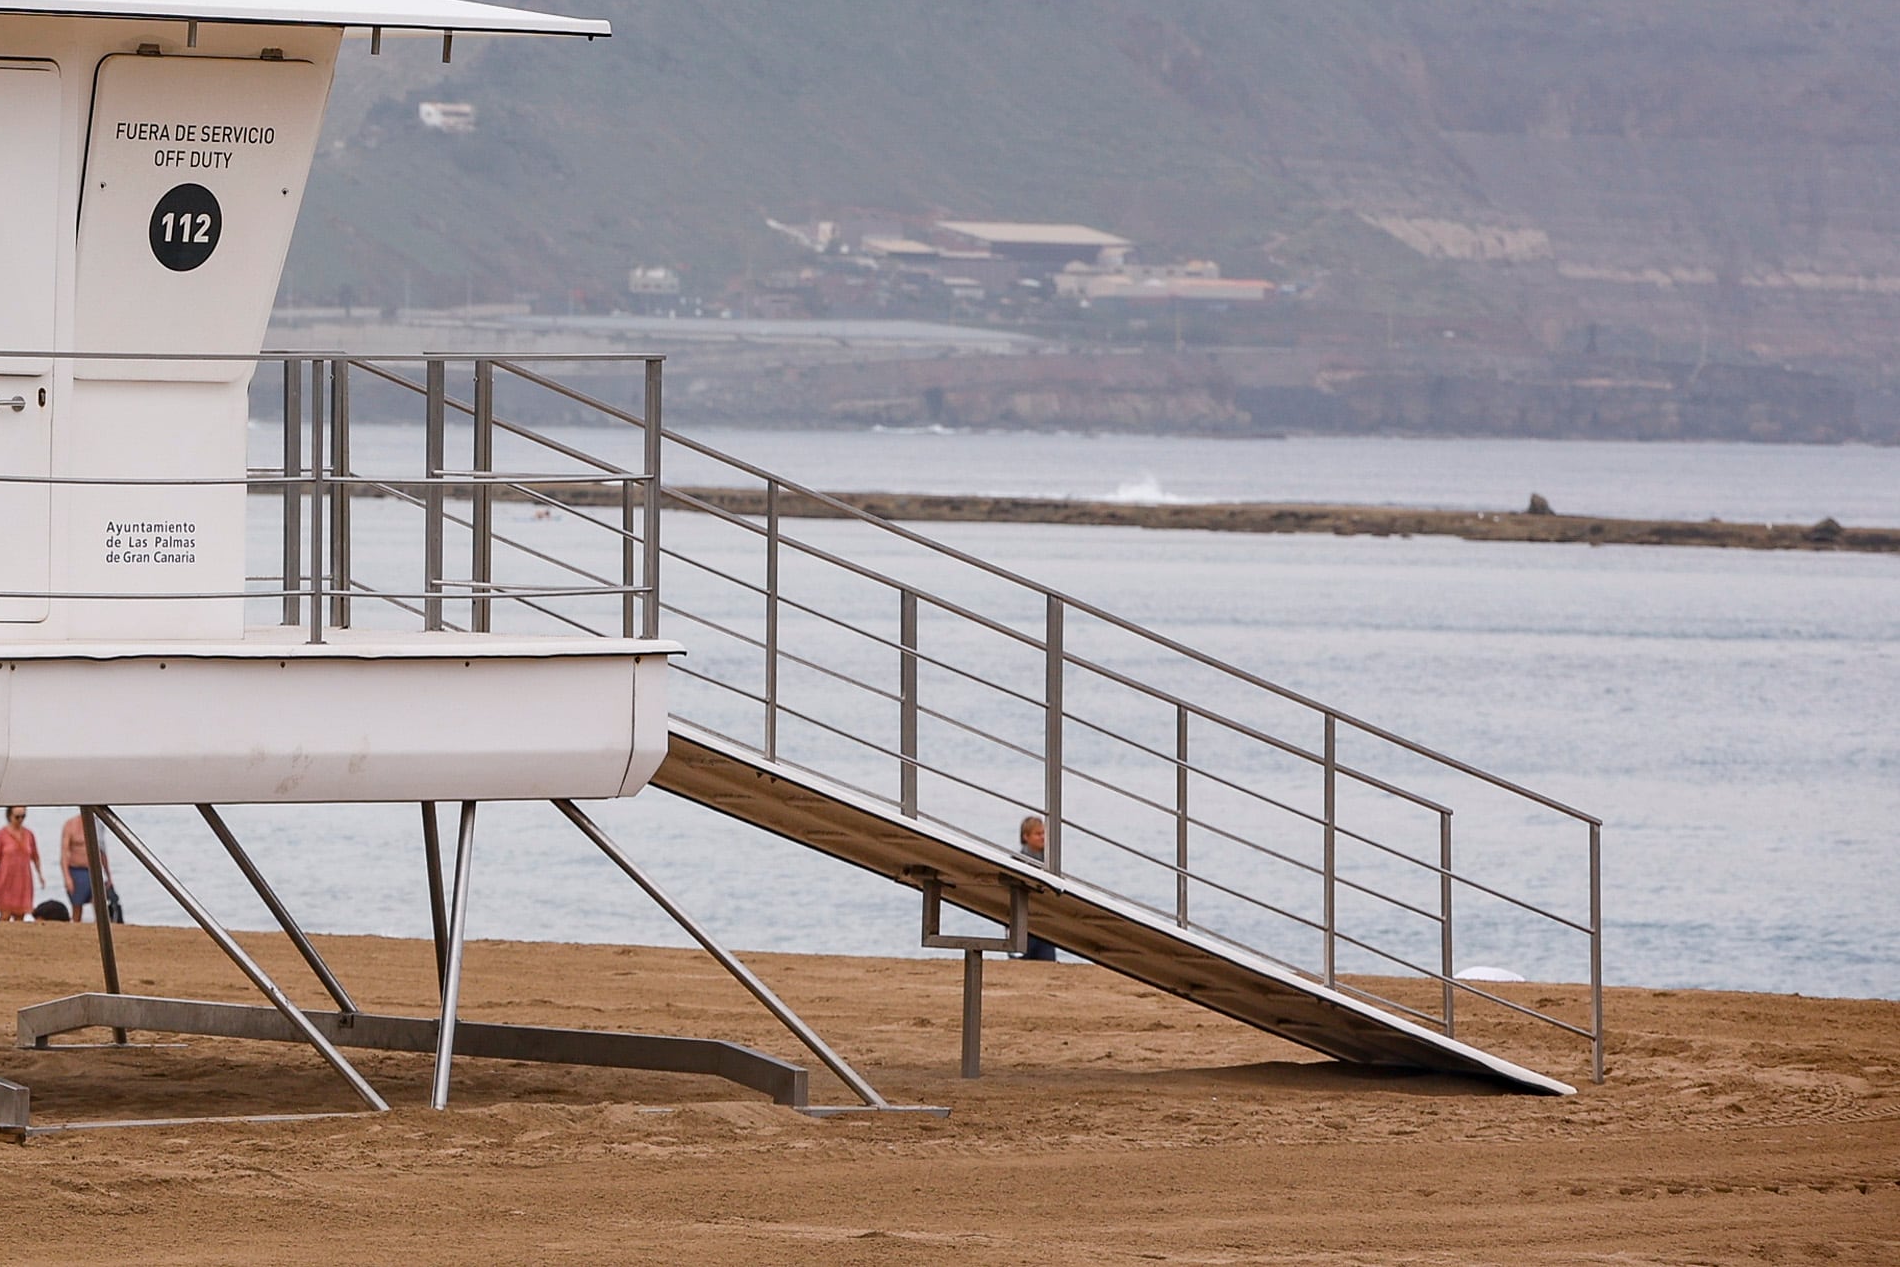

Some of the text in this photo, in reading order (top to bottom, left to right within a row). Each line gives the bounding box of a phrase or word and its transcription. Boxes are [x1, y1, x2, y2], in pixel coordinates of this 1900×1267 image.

[116, 122, 275, 144] FUERA DE SERVICIO
[154, 149, 233, 169] OFF DUTY
[161, 212, 212, 243] 112
[106, 521, 196, 536] Ayuntamiento
[106, 536, 196, 548] de Las Palmas
[106, 551, 195, 563] de Gran Canaria
